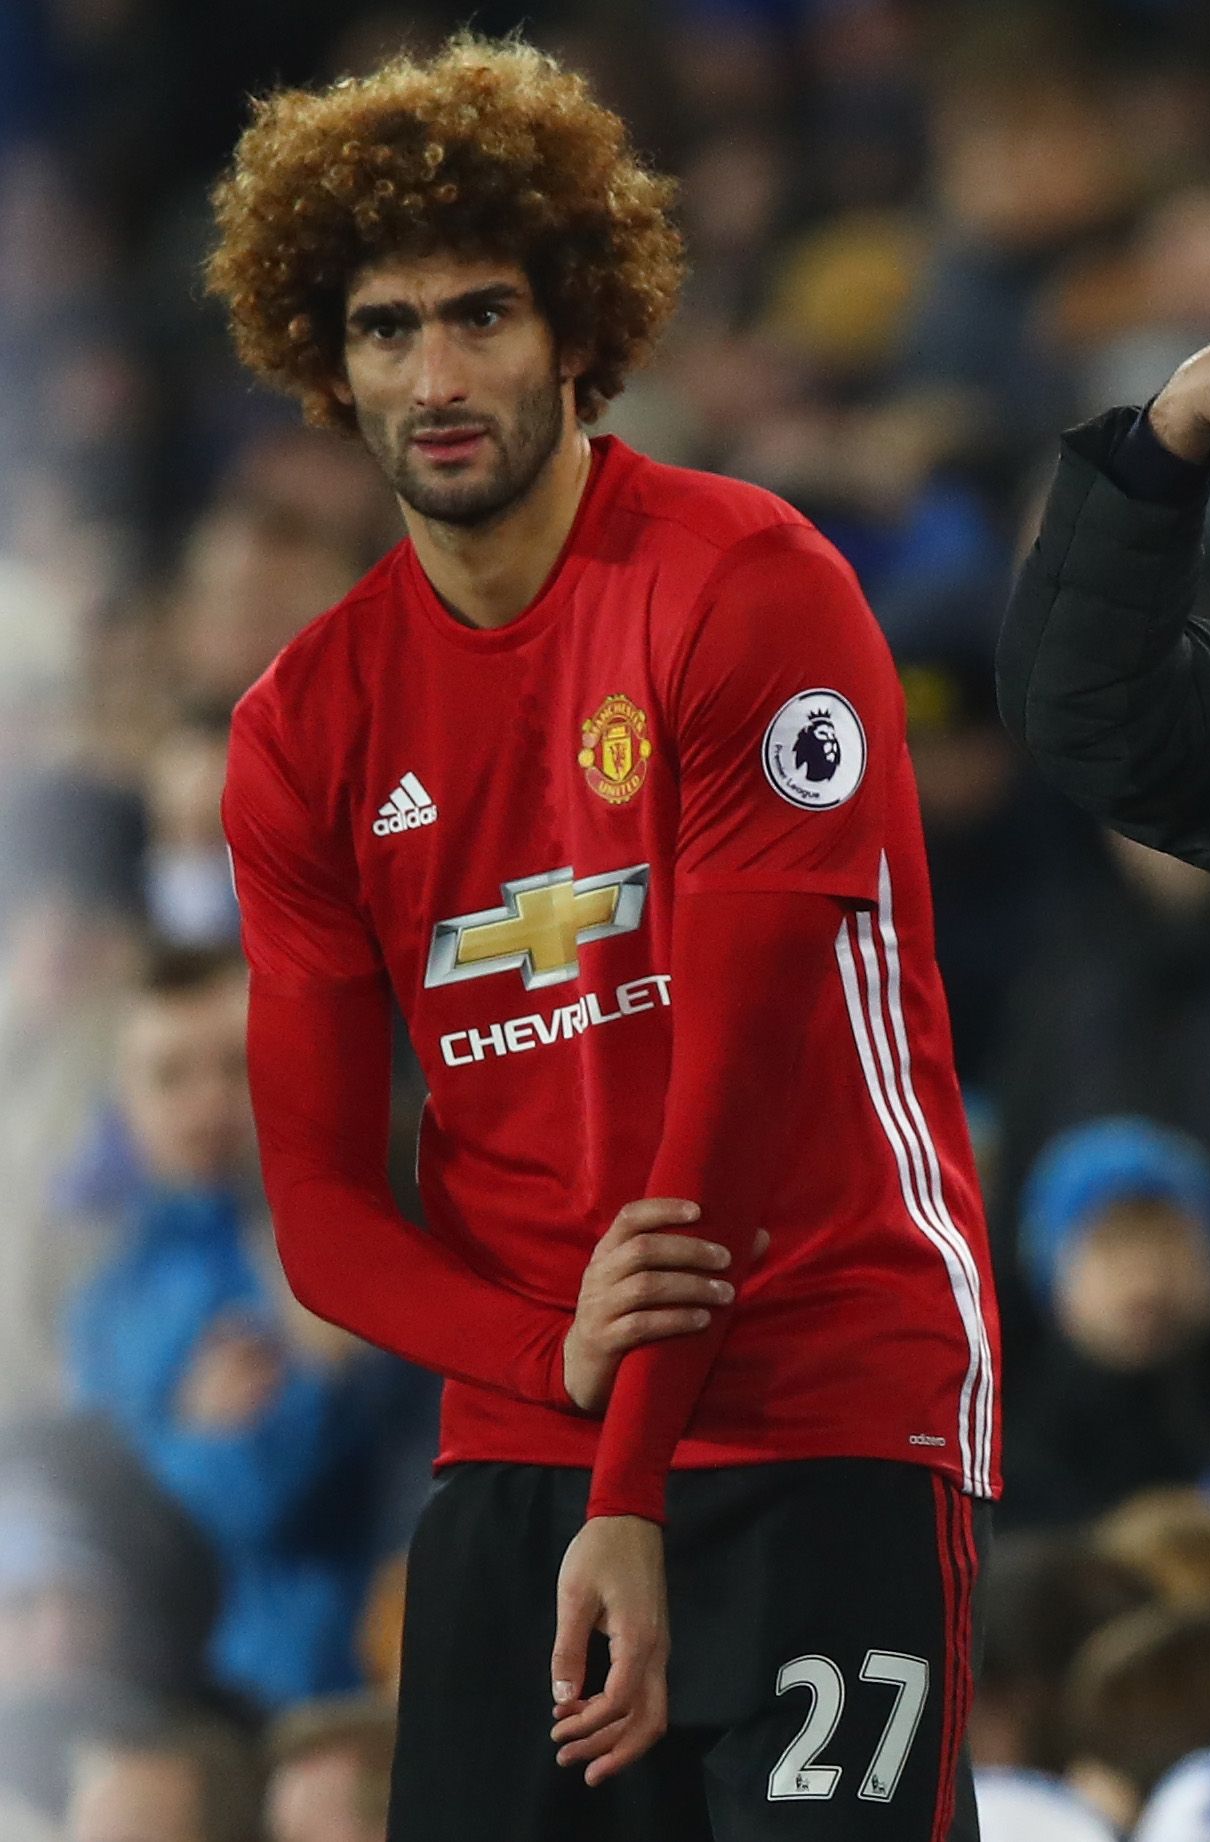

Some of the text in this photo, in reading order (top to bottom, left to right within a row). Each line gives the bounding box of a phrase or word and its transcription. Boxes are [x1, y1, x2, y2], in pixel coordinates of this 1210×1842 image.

[372, 804, 438, 836] adidas
[440, 974, 672, 1067] CHEVRLET
[767, 1650, 930, 1802] 27
